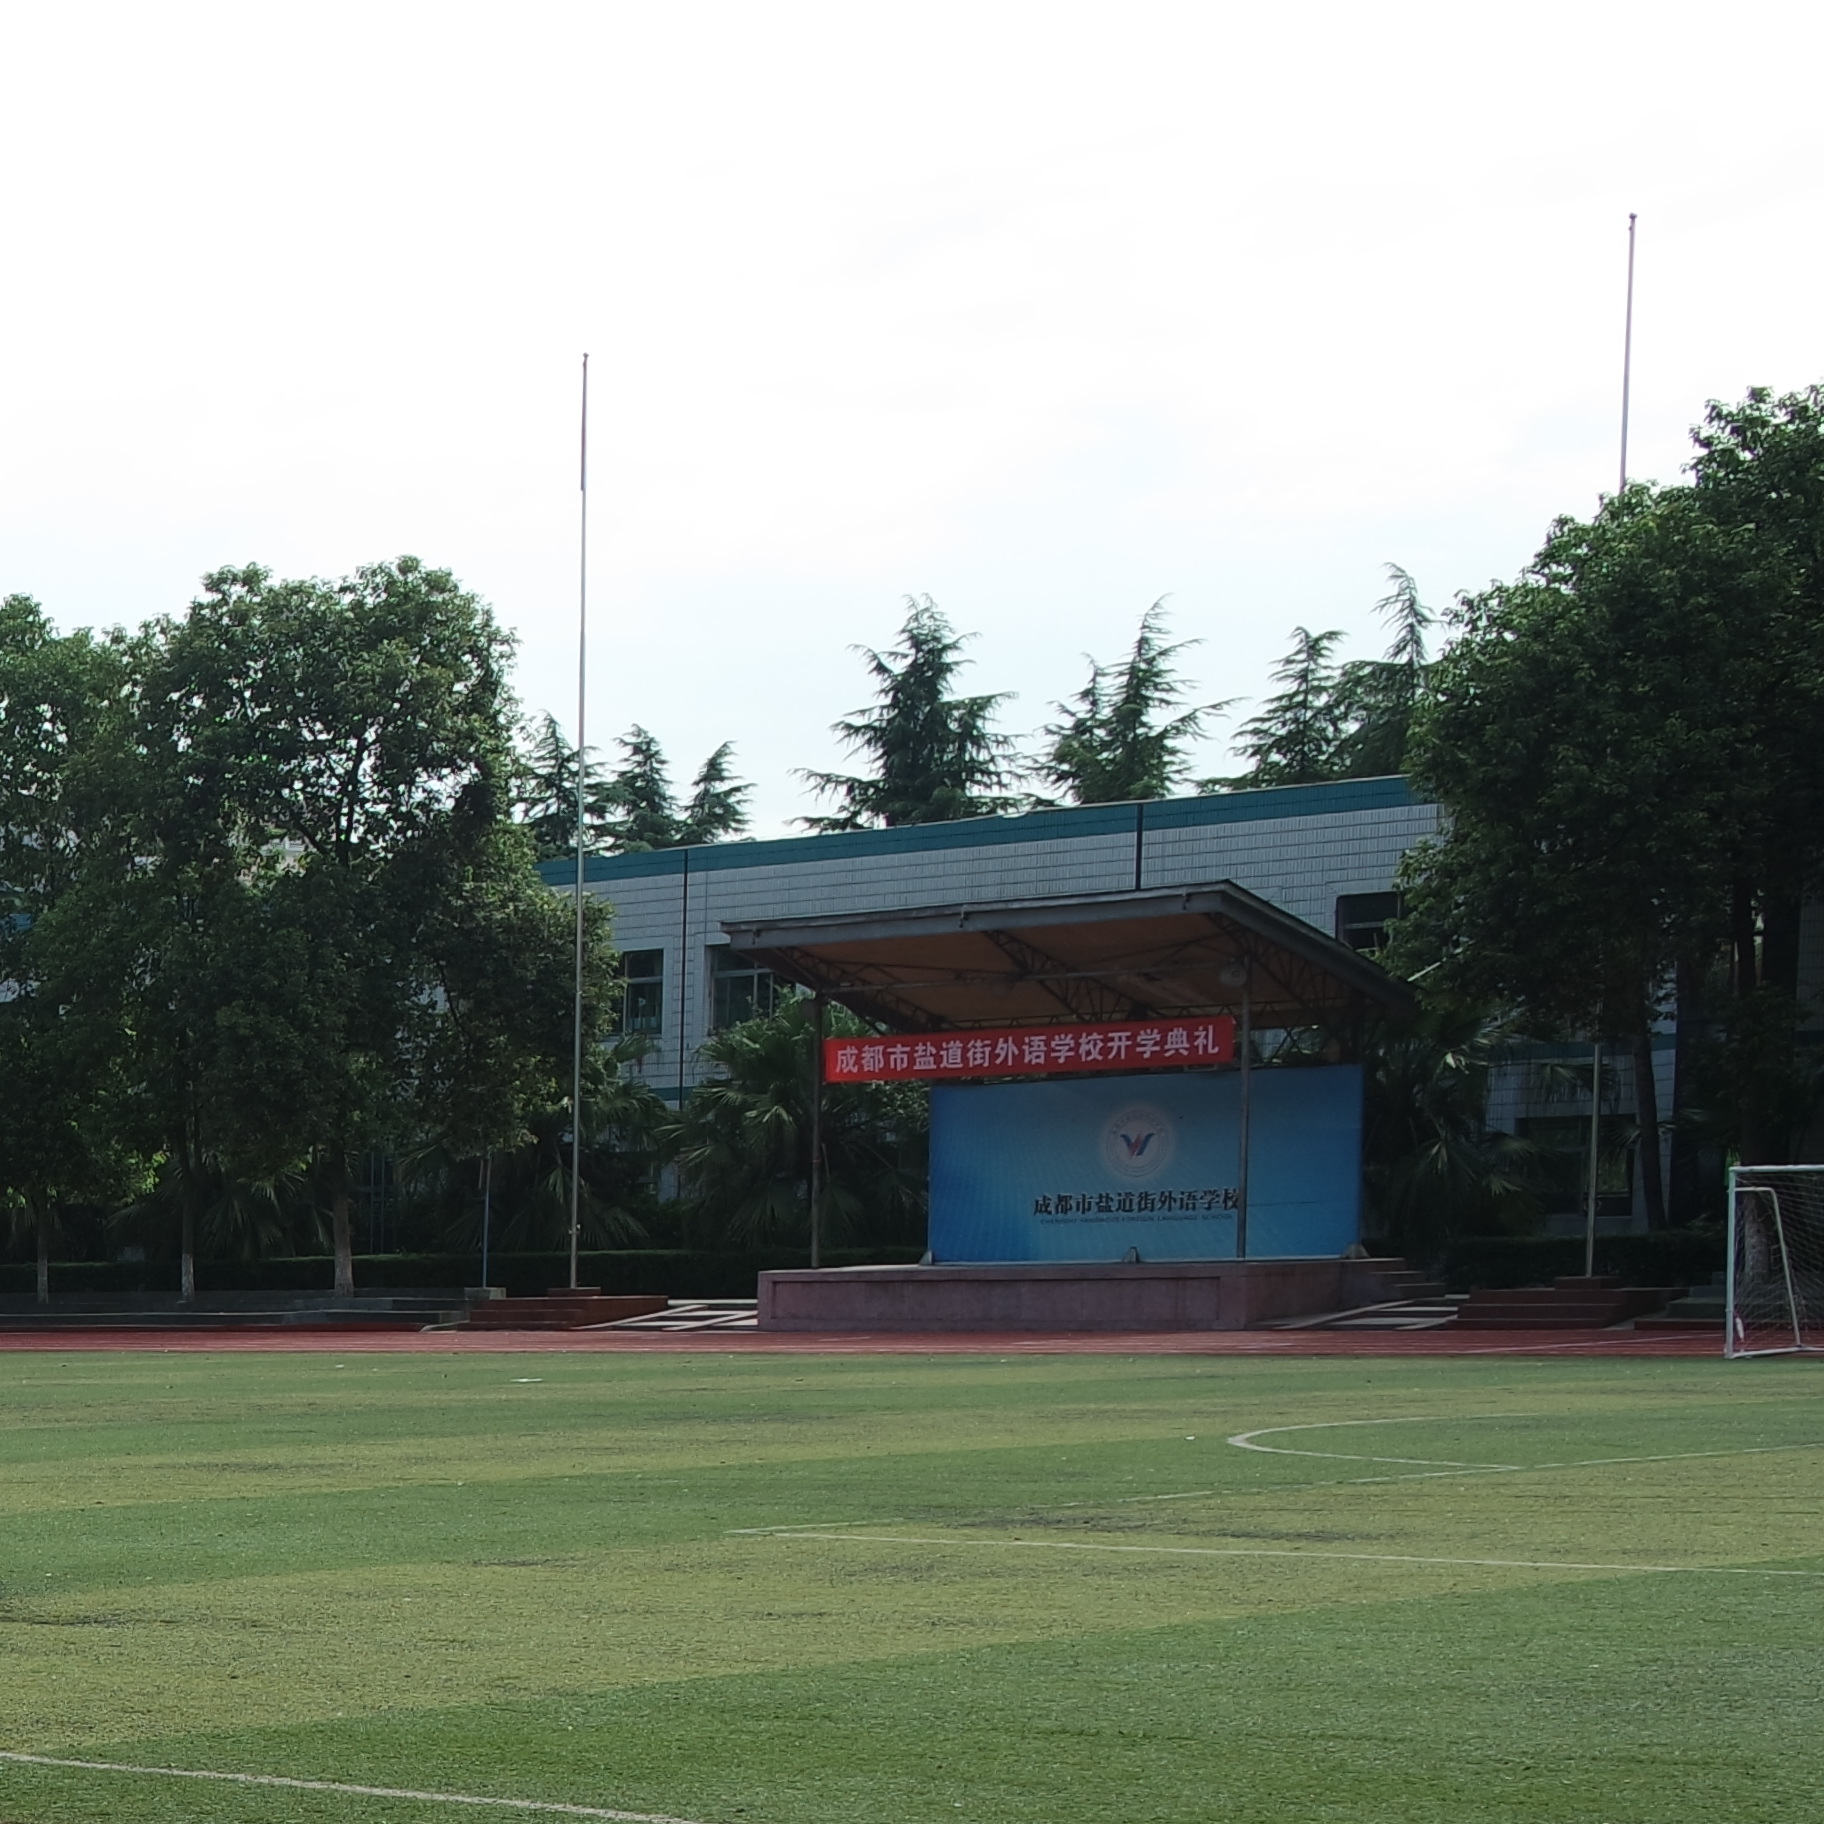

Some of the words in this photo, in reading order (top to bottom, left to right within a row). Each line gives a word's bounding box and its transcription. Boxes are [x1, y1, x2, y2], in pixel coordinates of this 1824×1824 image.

[835, 1025, 1221, 1074] 成都市盐道街外语学校开学典礼
[1034, 1188, 1240, 1216] 成都市盐道街外语学校
